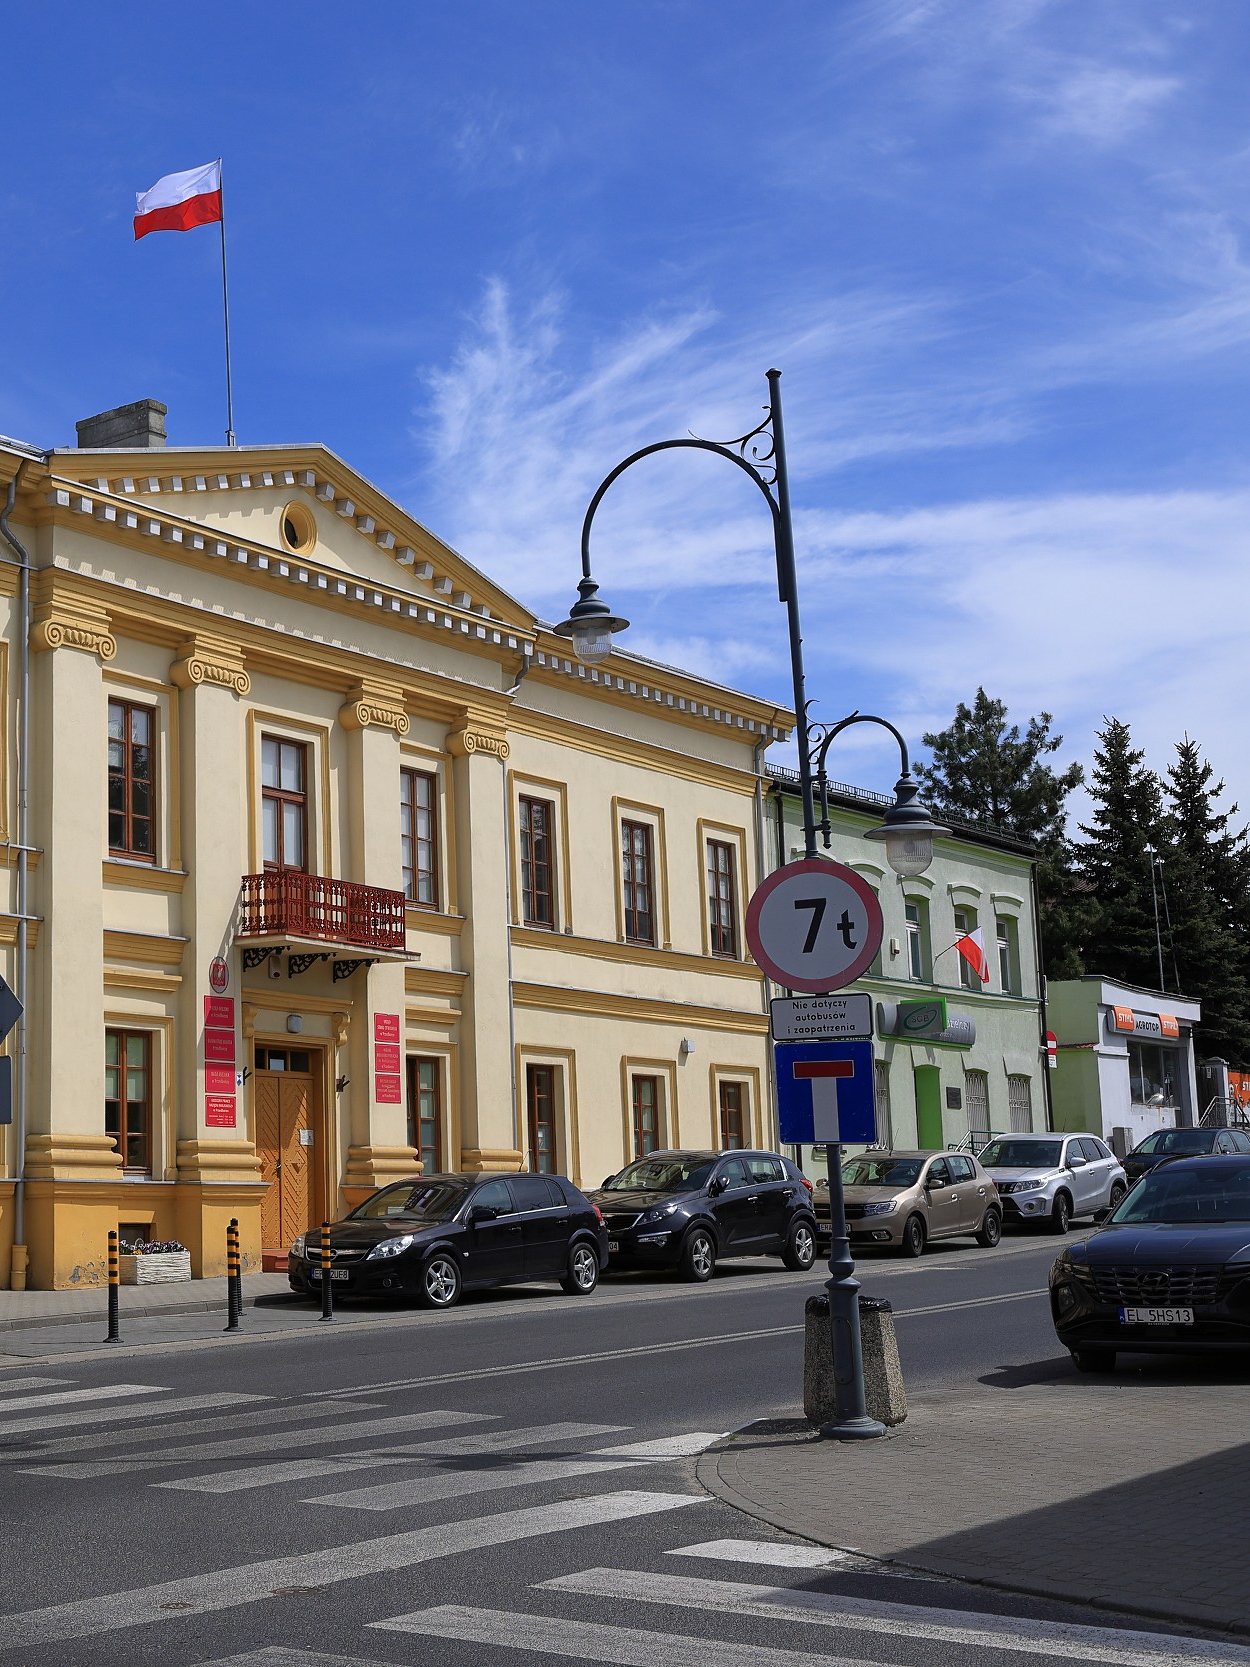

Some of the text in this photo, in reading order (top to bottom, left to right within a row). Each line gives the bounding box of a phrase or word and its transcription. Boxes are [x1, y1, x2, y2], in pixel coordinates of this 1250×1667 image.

[794, 897, 858, 954] 7 t
[792, 1000, 847, 1010] Nie dotyczy
[795, 1011, 846, 1021] autobusów
[911, 1014, 929, 1023] SGB
[787, 1022, 856, 1035] i zaopatrzenia
[1126, 1309, 1191, 1322] EL 5HS13
